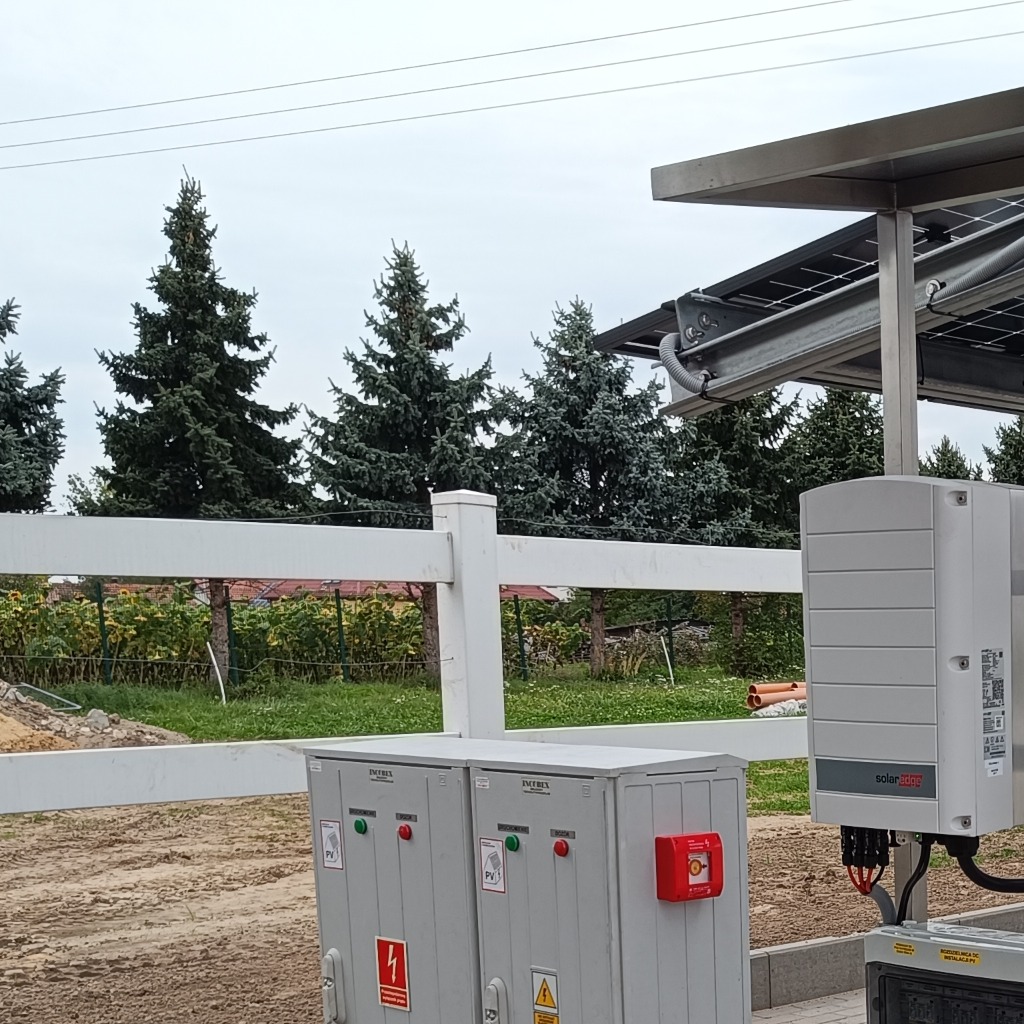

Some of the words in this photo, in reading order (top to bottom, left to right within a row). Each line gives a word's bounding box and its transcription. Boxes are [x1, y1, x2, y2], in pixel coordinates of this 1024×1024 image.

[875, 773, 923, 787] solaredge
[326, 847, 334, 859] PV
[485, 870, 495, 881] PV
